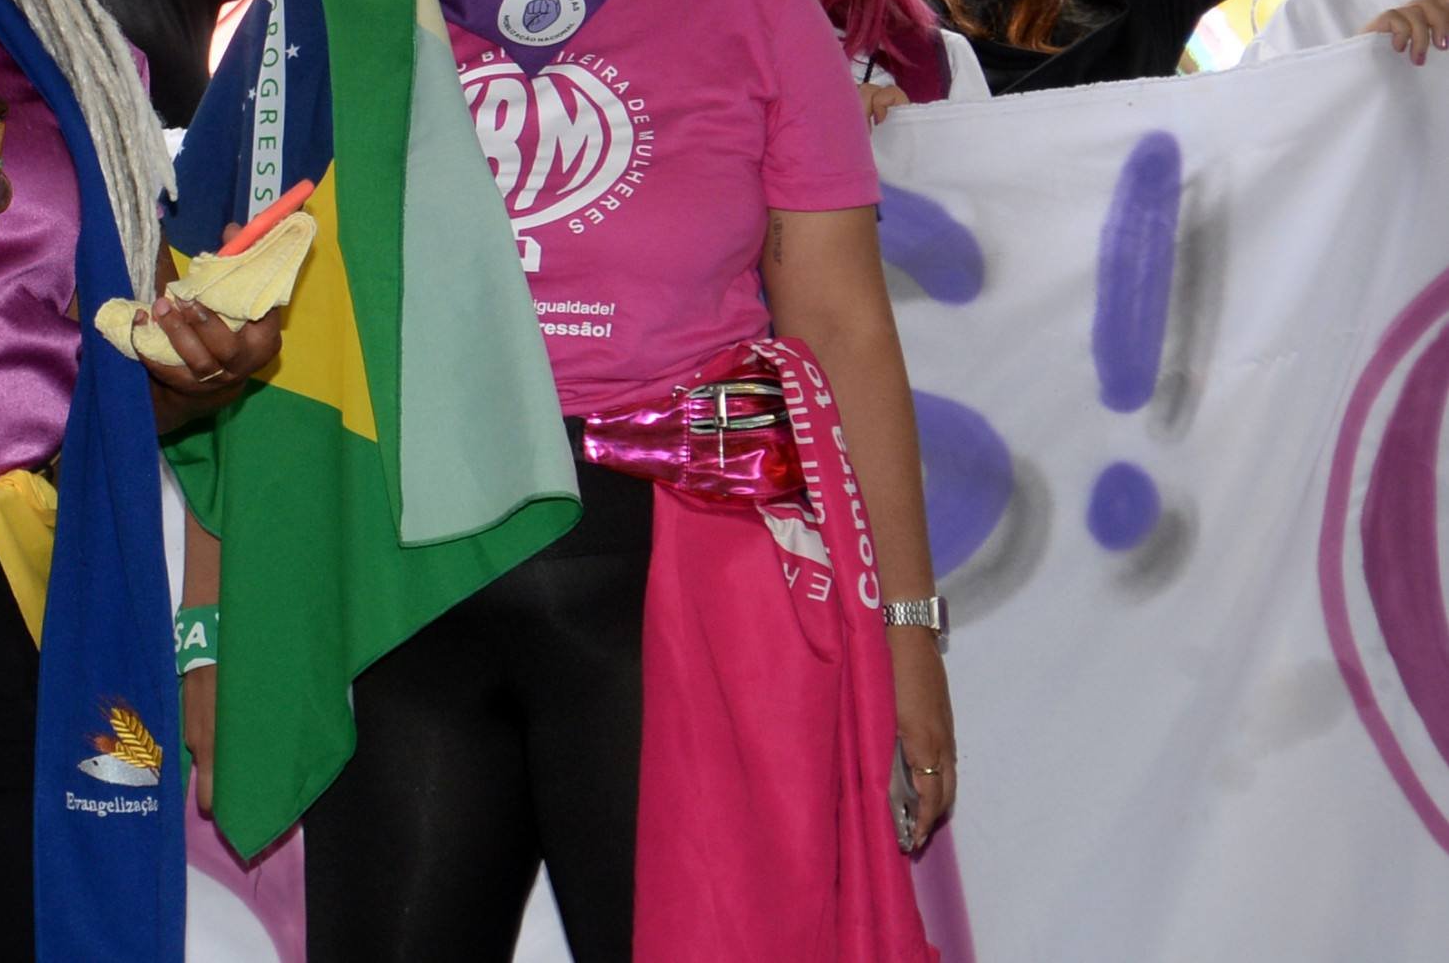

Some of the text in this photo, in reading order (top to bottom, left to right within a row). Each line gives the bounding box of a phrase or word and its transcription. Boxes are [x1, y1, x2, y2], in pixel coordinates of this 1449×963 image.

[464, 74, 604, 211] BM
[628, 98, 650, 125] DE
[568, 130, 655, 234] MULHERES
[538, 321, 612, 338] ressão!
[831, 426, 880, 609] Contra
